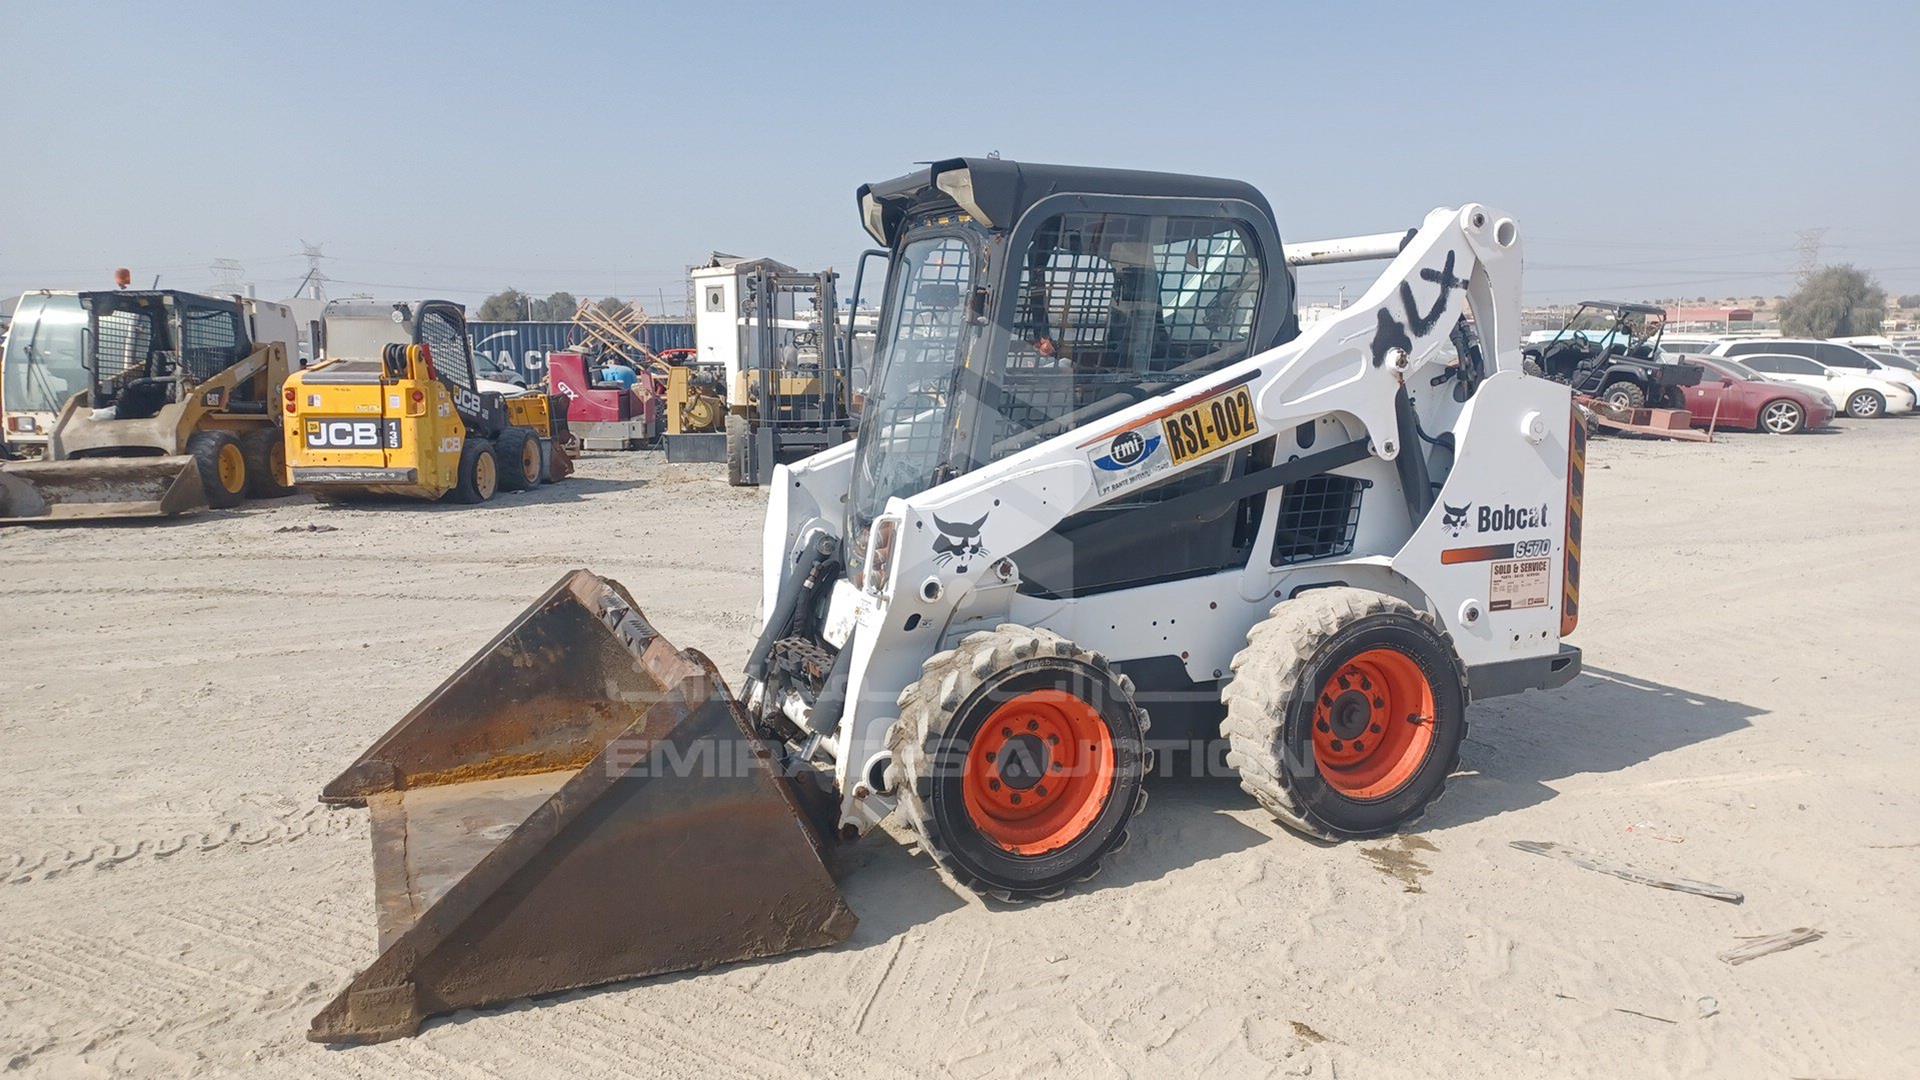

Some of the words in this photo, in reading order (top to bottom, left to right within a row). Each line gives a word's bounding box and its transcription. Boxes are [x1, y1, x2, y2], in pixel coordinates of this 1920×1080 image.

[453, 387, 480, 412] JCB
[557, 382, 579, 400] GTX
[308, 422, 378, 446] JCB
[388, 421, 399, 448] 135
[1165, 391, 1254, 461] RSL-002
[438, 437, 460, 453] JCB
[1113, 434, 1140, 459] rmi
[1477, 503, 1549, 533] Bobcat
[1514, 538, 1551, 558] S570
[1494, 563, 1512, 576] SOLD
[1513, 563, 1519, 573] &
[1520, 560, 1547, 573] SERVICE
